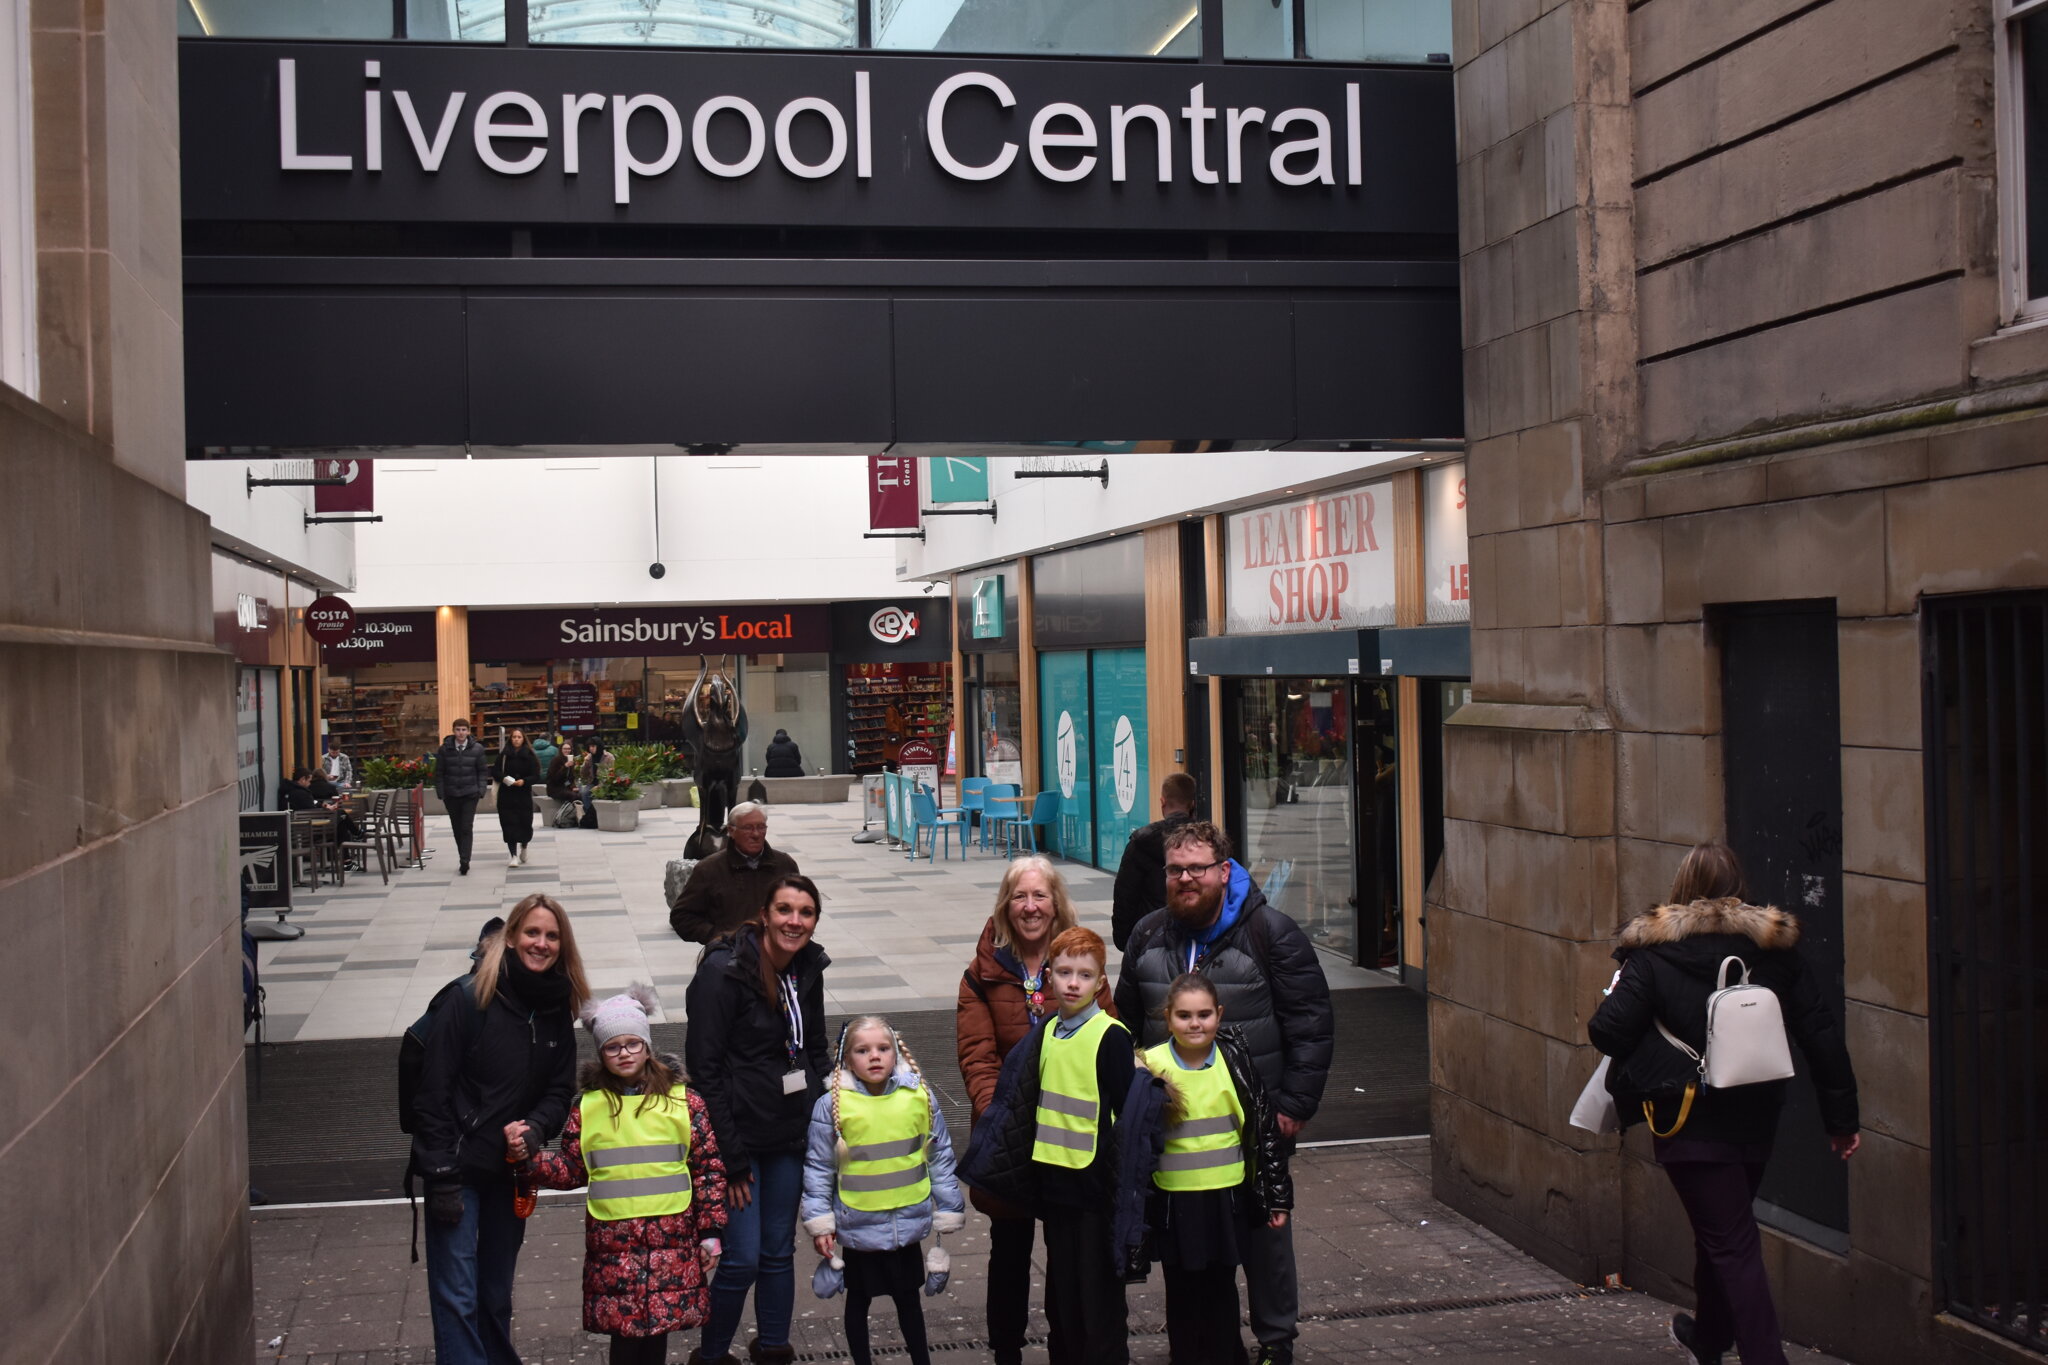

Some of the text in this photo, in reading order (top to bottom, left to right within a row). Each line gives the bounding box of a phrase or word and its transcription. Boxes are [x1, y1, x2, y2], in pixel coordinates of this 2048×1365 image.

[279, 58, 1363, 204] Liverpool Central
[1241, 491, 1379, 570] LEATHER
[1269, 561, 1350, 625] SHOP
[311, 610, 349, 621] COSTA
[317, 622, 345, 631] pronto
[365, 622, 413, 635] 10.30pm
[560, 614, 793, 646] Sainsbury's Local
[904, 746, 934, 756] TIMPSON
